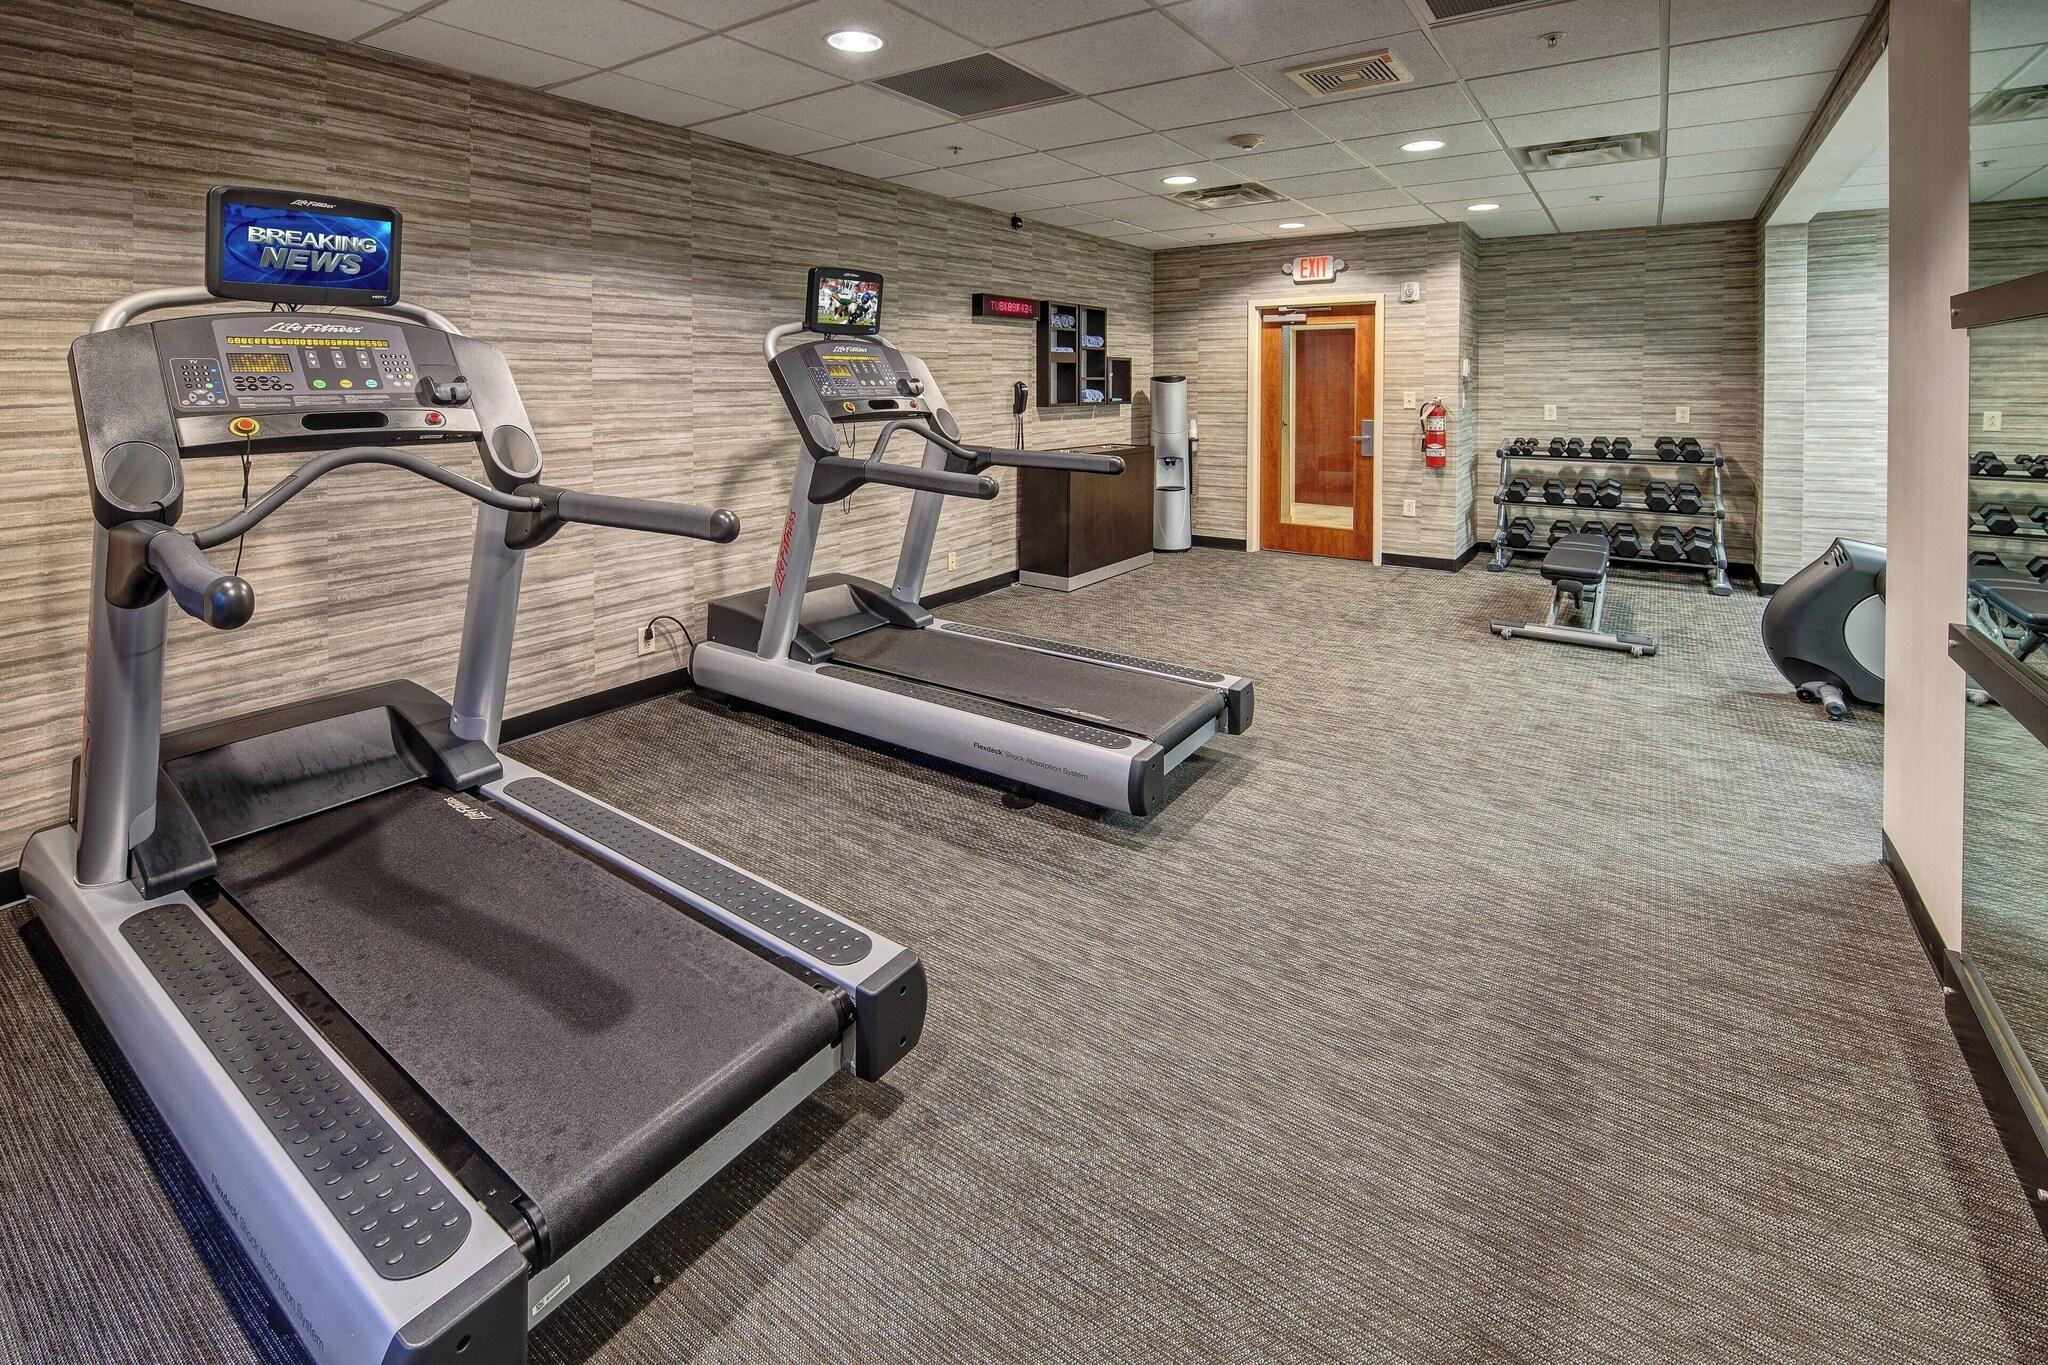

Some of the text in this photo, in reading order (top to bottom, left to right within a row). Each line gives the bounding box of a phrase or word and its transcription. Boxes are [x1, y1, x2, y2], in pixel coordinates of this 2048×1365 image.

[248, 226, 377, 254] BREAKING
[259, 247, 363, 275] NEWS
[1300, 256, 1328, 278] EXIT
[263, 322, 364, 334] Life Fitness
[973, 741, 1090, 781] Flexdeck Shock Absorption System
